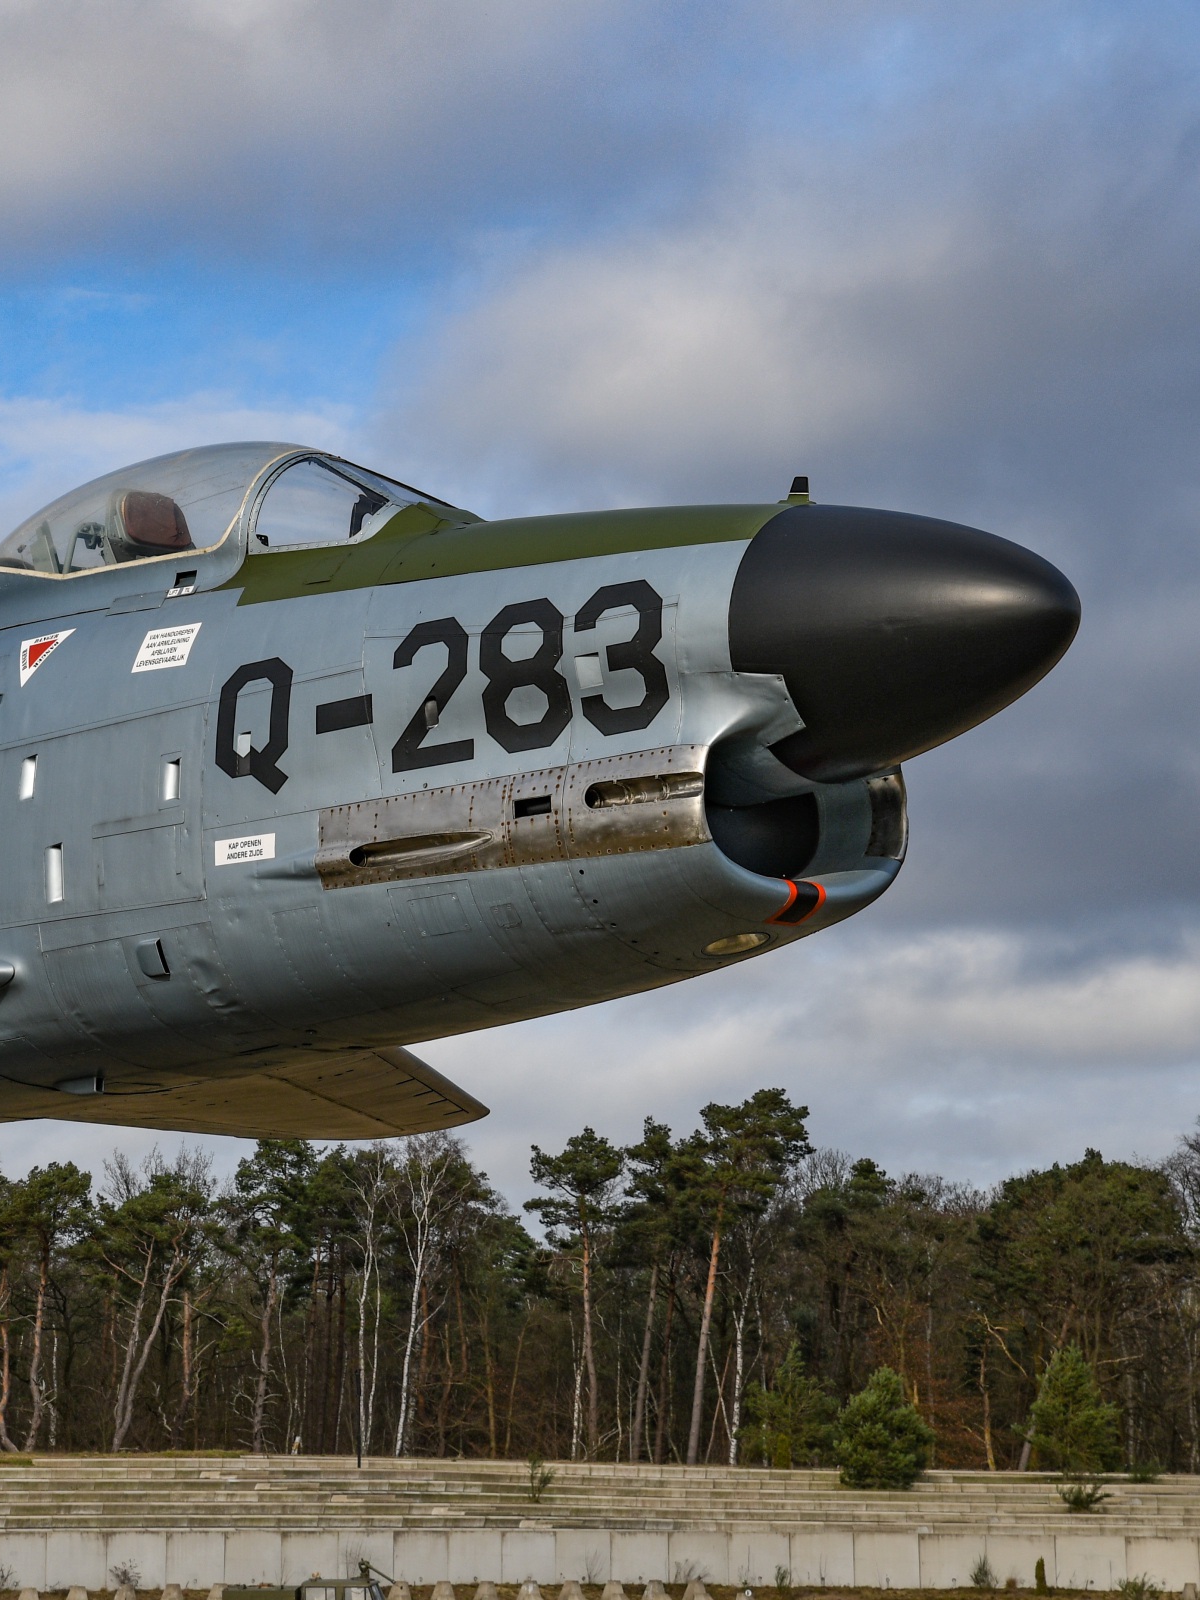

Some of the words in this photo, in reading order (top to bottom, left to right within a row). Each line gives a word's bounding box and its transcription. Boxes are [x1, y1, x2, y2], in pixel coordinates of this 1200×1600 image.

[34, 633, 60, 643] DANGER
[160, 628, 196, 639] HANDGREPEN
[145, 641, 158, 649] AAN
[157, 636, 191, 647] ARMLEUNING
[150, 646, 178, 656] AFBLIJVEN
[136, 653, 186, 667] LEVENSGEVAARLIJK
[215, 579, 670, 793] Q-283
[228, 842, 239, 850] KAP
[239, 838, 262, 849] OPENEN
[226, 850, 248, 860] ANDERE
[248, 848, 263, 857] ZIJDE
